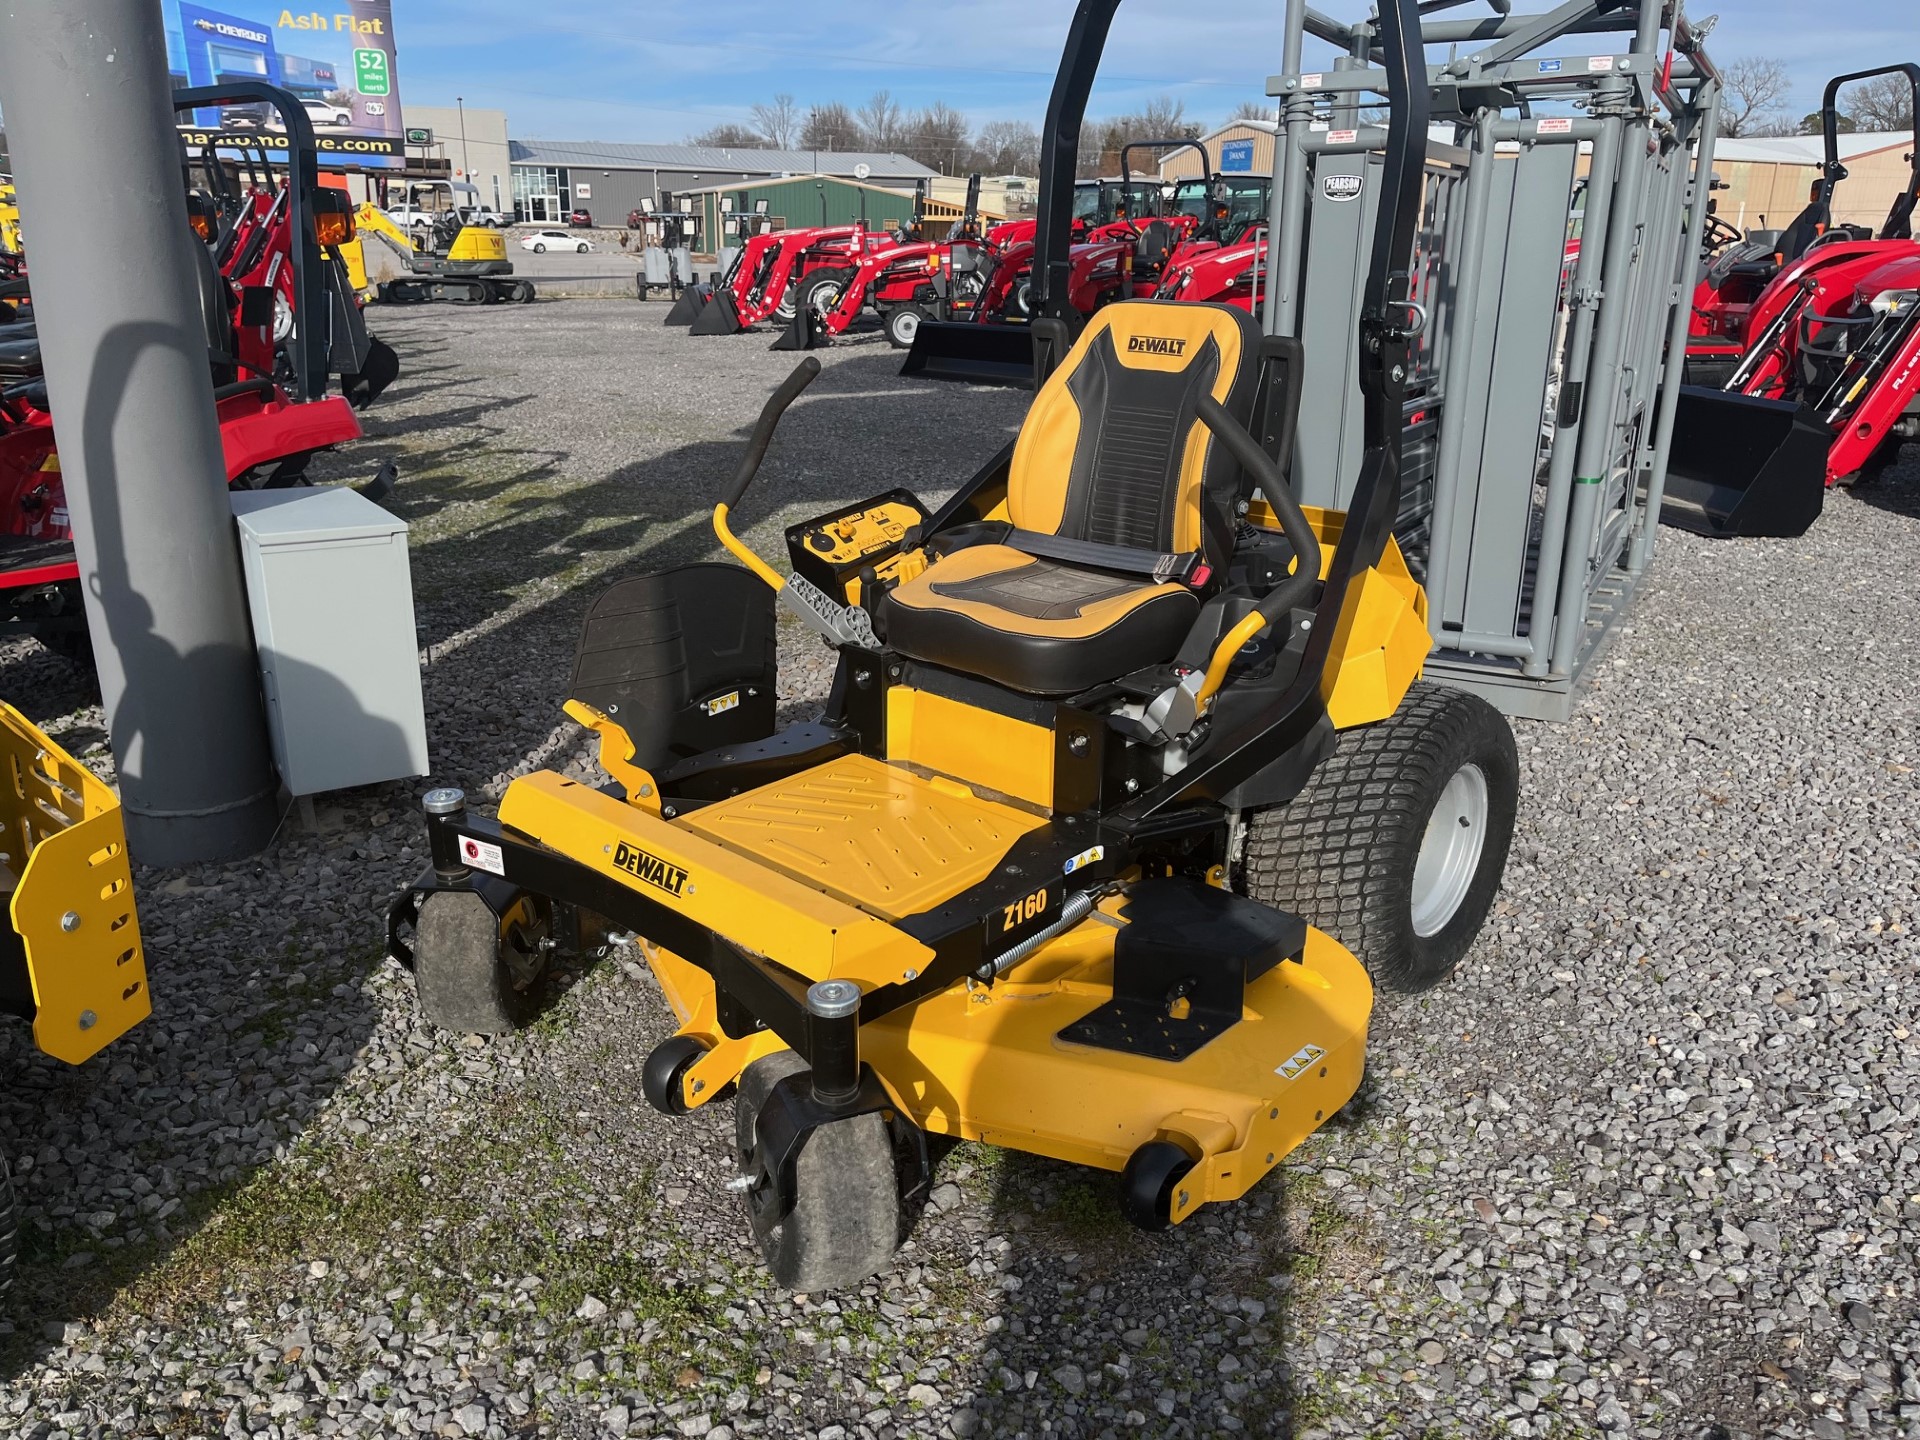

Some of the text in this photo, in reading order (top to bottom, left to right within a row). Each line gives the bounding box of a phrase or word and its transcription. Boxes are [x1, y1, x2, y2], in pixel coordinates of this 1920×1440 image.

[278, 9, 384, 35] Ash Flat
[216, 22, 268, 43] CHEVROLET
[359, 51, 384, 70] 52
[363, 72, 384, 81] miles
[364, 84, 385, 92] north
[367, 104, 382, 112] 167
[1326, 177, 1360, 190] PEARSON
[1003, 888, 1047, 932] Z160
